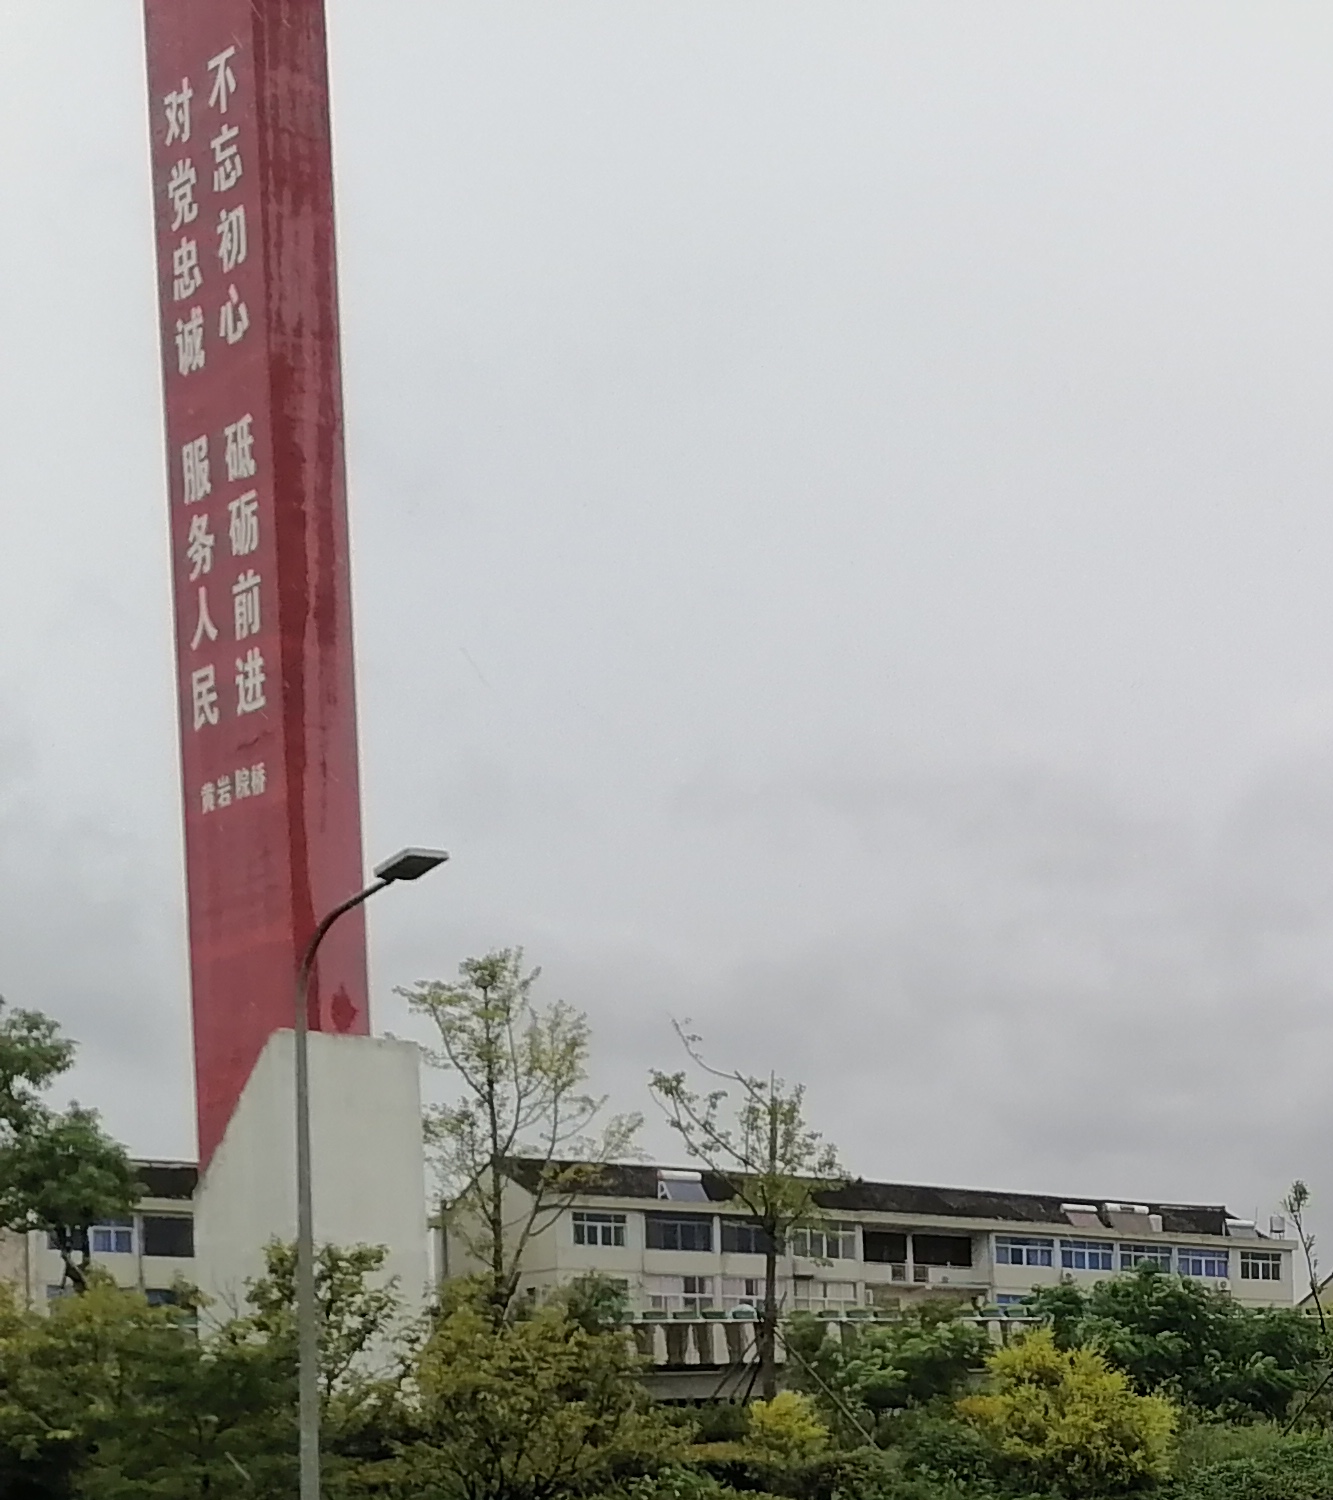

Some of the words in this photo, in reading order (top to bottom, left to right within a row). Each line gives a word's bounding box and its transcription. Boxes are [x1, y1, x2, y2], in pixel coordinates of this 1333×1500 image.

[164, 76, 206, 377] 对党忠诚
[207, 45, 250, 345] 不忘初心
[182, 434, 220, 732] 服务人民
[224, 413, 266, 717] 砥砺前进
